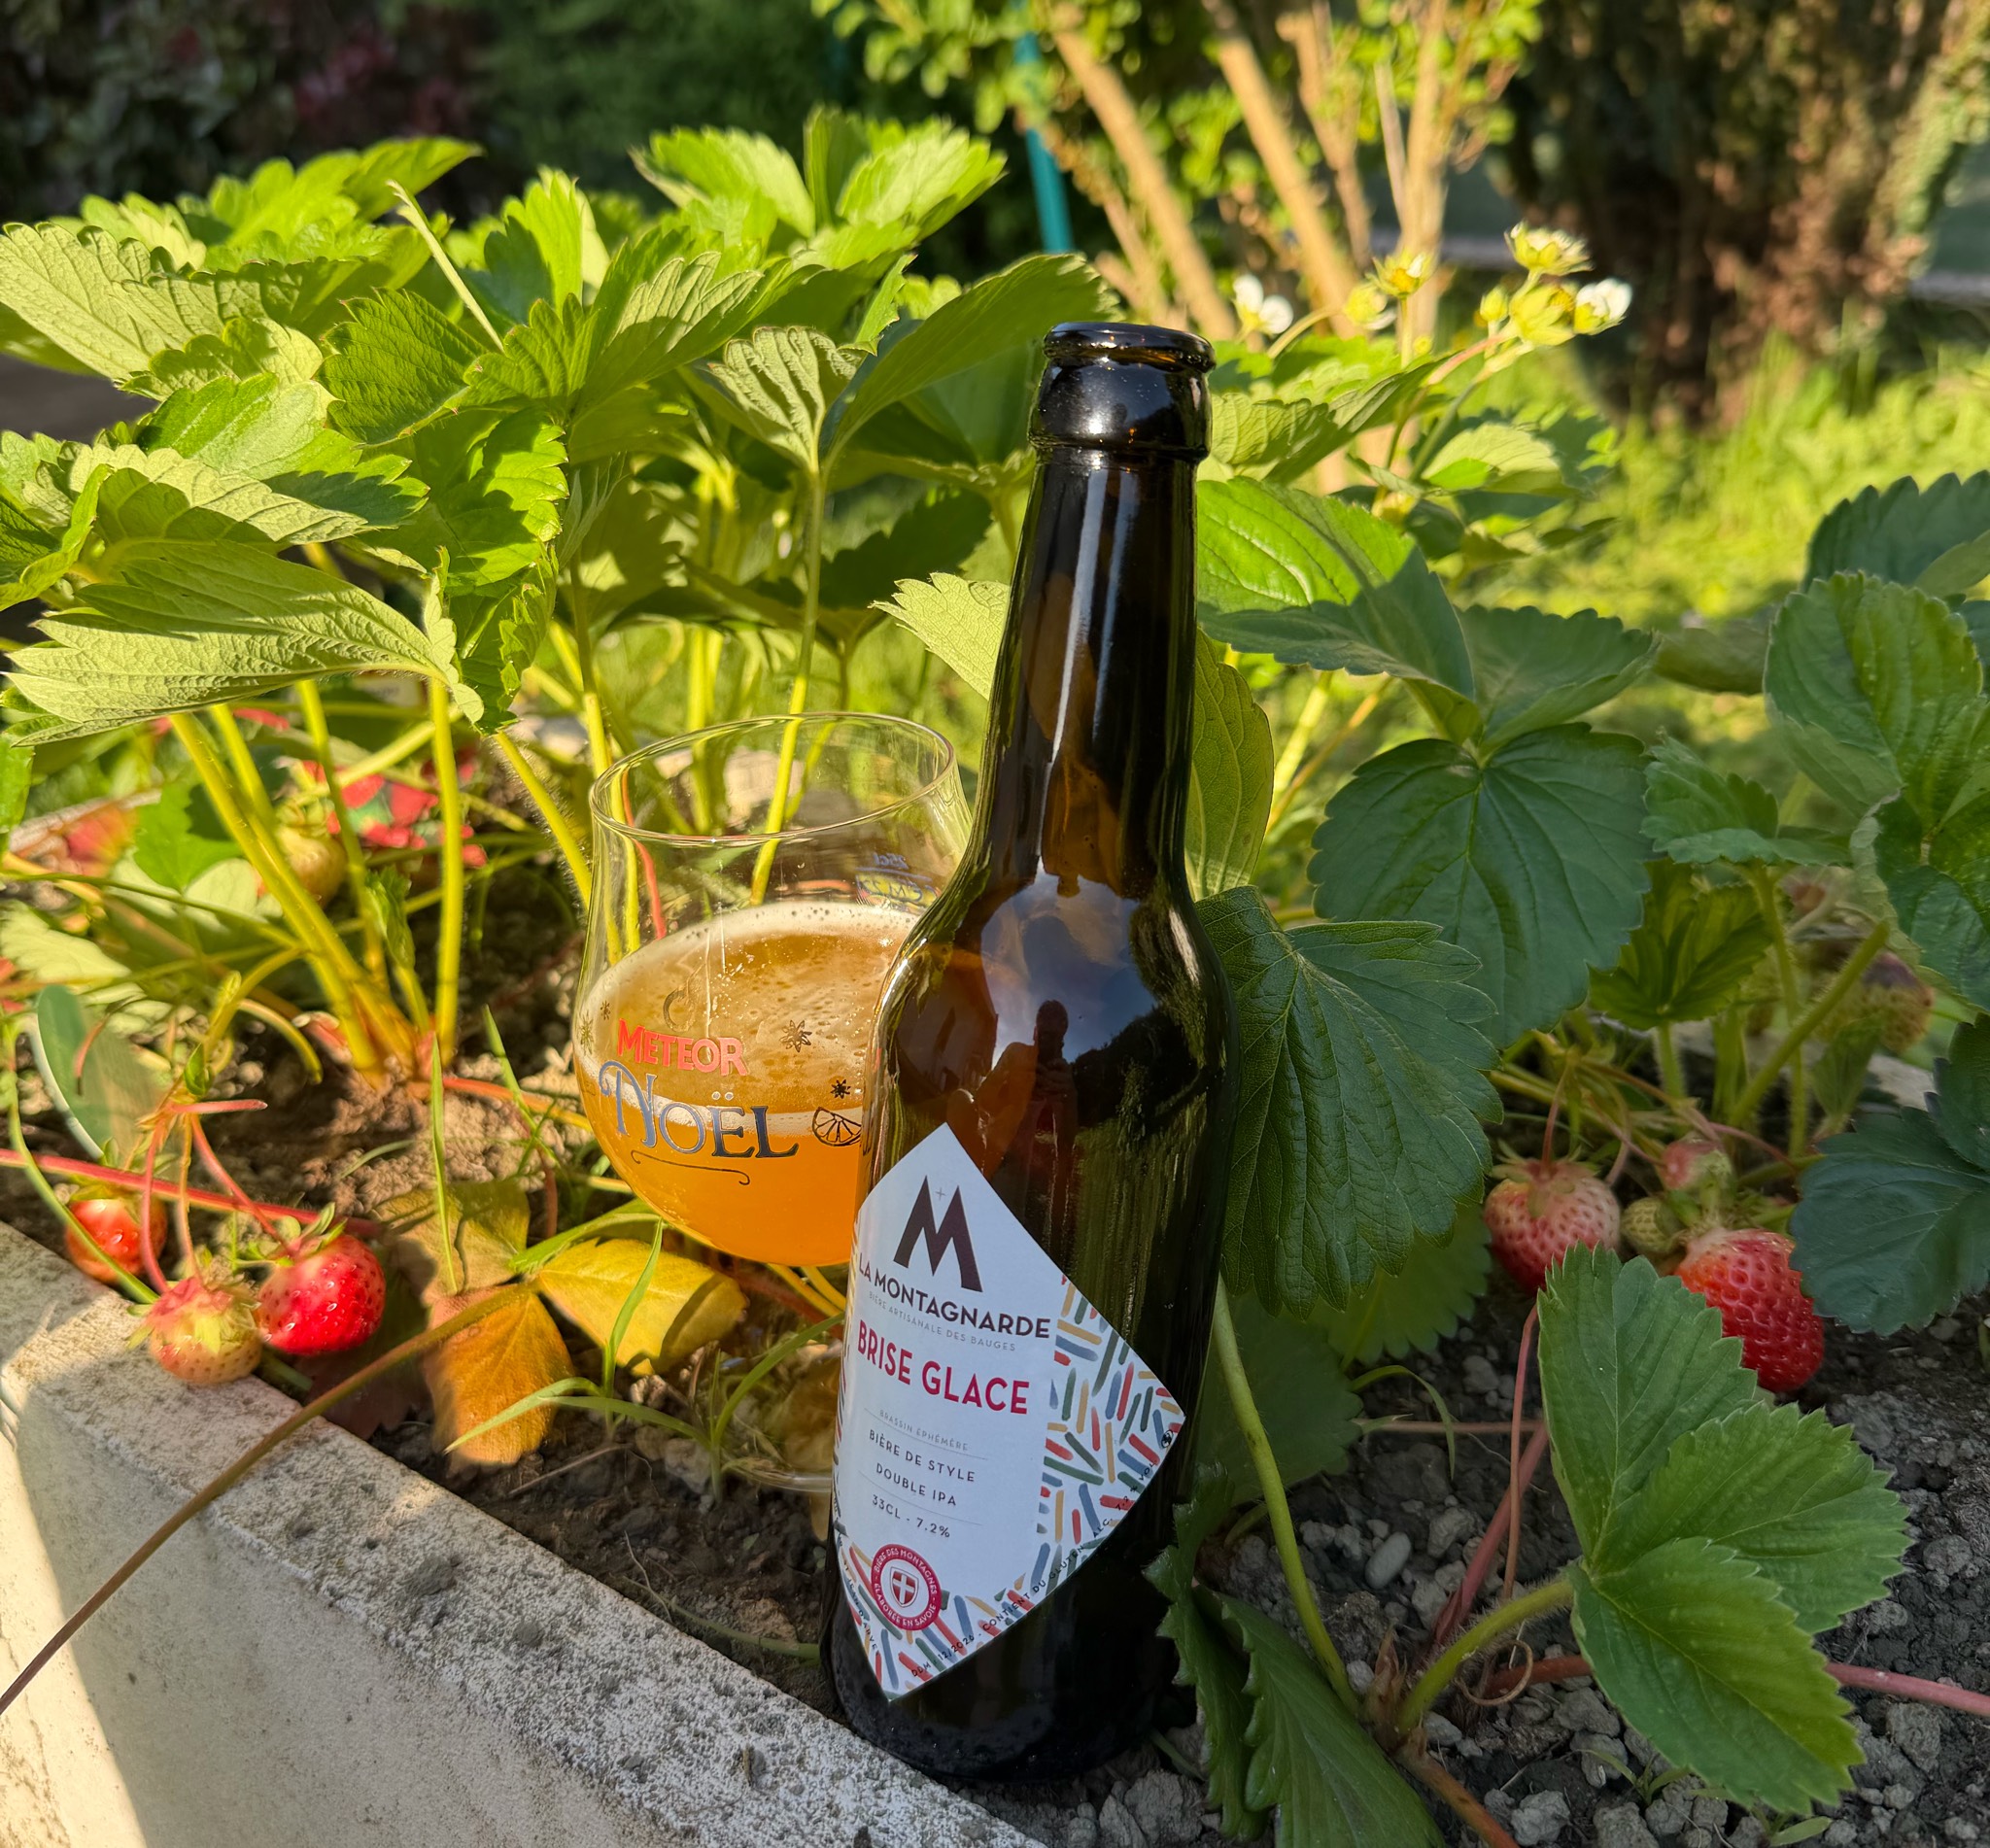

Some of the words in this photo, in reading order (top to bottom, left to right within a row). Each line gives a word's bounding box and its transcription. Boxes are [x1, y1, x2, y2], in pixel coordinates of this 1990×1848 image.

[617, 1017, 748, 1077] METEOR
[893, 1175, 983, 1293] M
[859, 1252, 872, 1283] LA
[874, 1268, 1051, 1339] MONTAGNARDE
[888, 1306, 943, 1335] ARTISANALE
[946, 1329, 967, 1342] DES
[971, 1336, 1016, 1352] BAUGES
[857, 1319, 913, 1386] BRISE
[922, 1360, 1030, 1415] GLACE
[879, 1409, 913, 1432] BRASSIN
[869, 1429, 901, 1456] BIÈRE
[906, 1451, 922, 1466] DE
[928, 1459, 976, 1483] STYLE
[875, 1462, 926, 1496] DOUBLE
[933, 1489, 957, 1506] IPA
[872, 1494, 901, 1520] 33CL
[916, 1518, 950, 1538] 7.2%
[886, 1548, 900, 1557] DES
[900, 1549, 938, 1594] MONTAGNES
[982, 1592, 1031, 1631] CONTIENT
[1032, 1580, 1046, 1593] DU
[1049, 1545, 1085, 1580] GLUTEN
[902, 1618, 913, 1626] EN
[914, 1604, 937, 1626] SAVOIE
